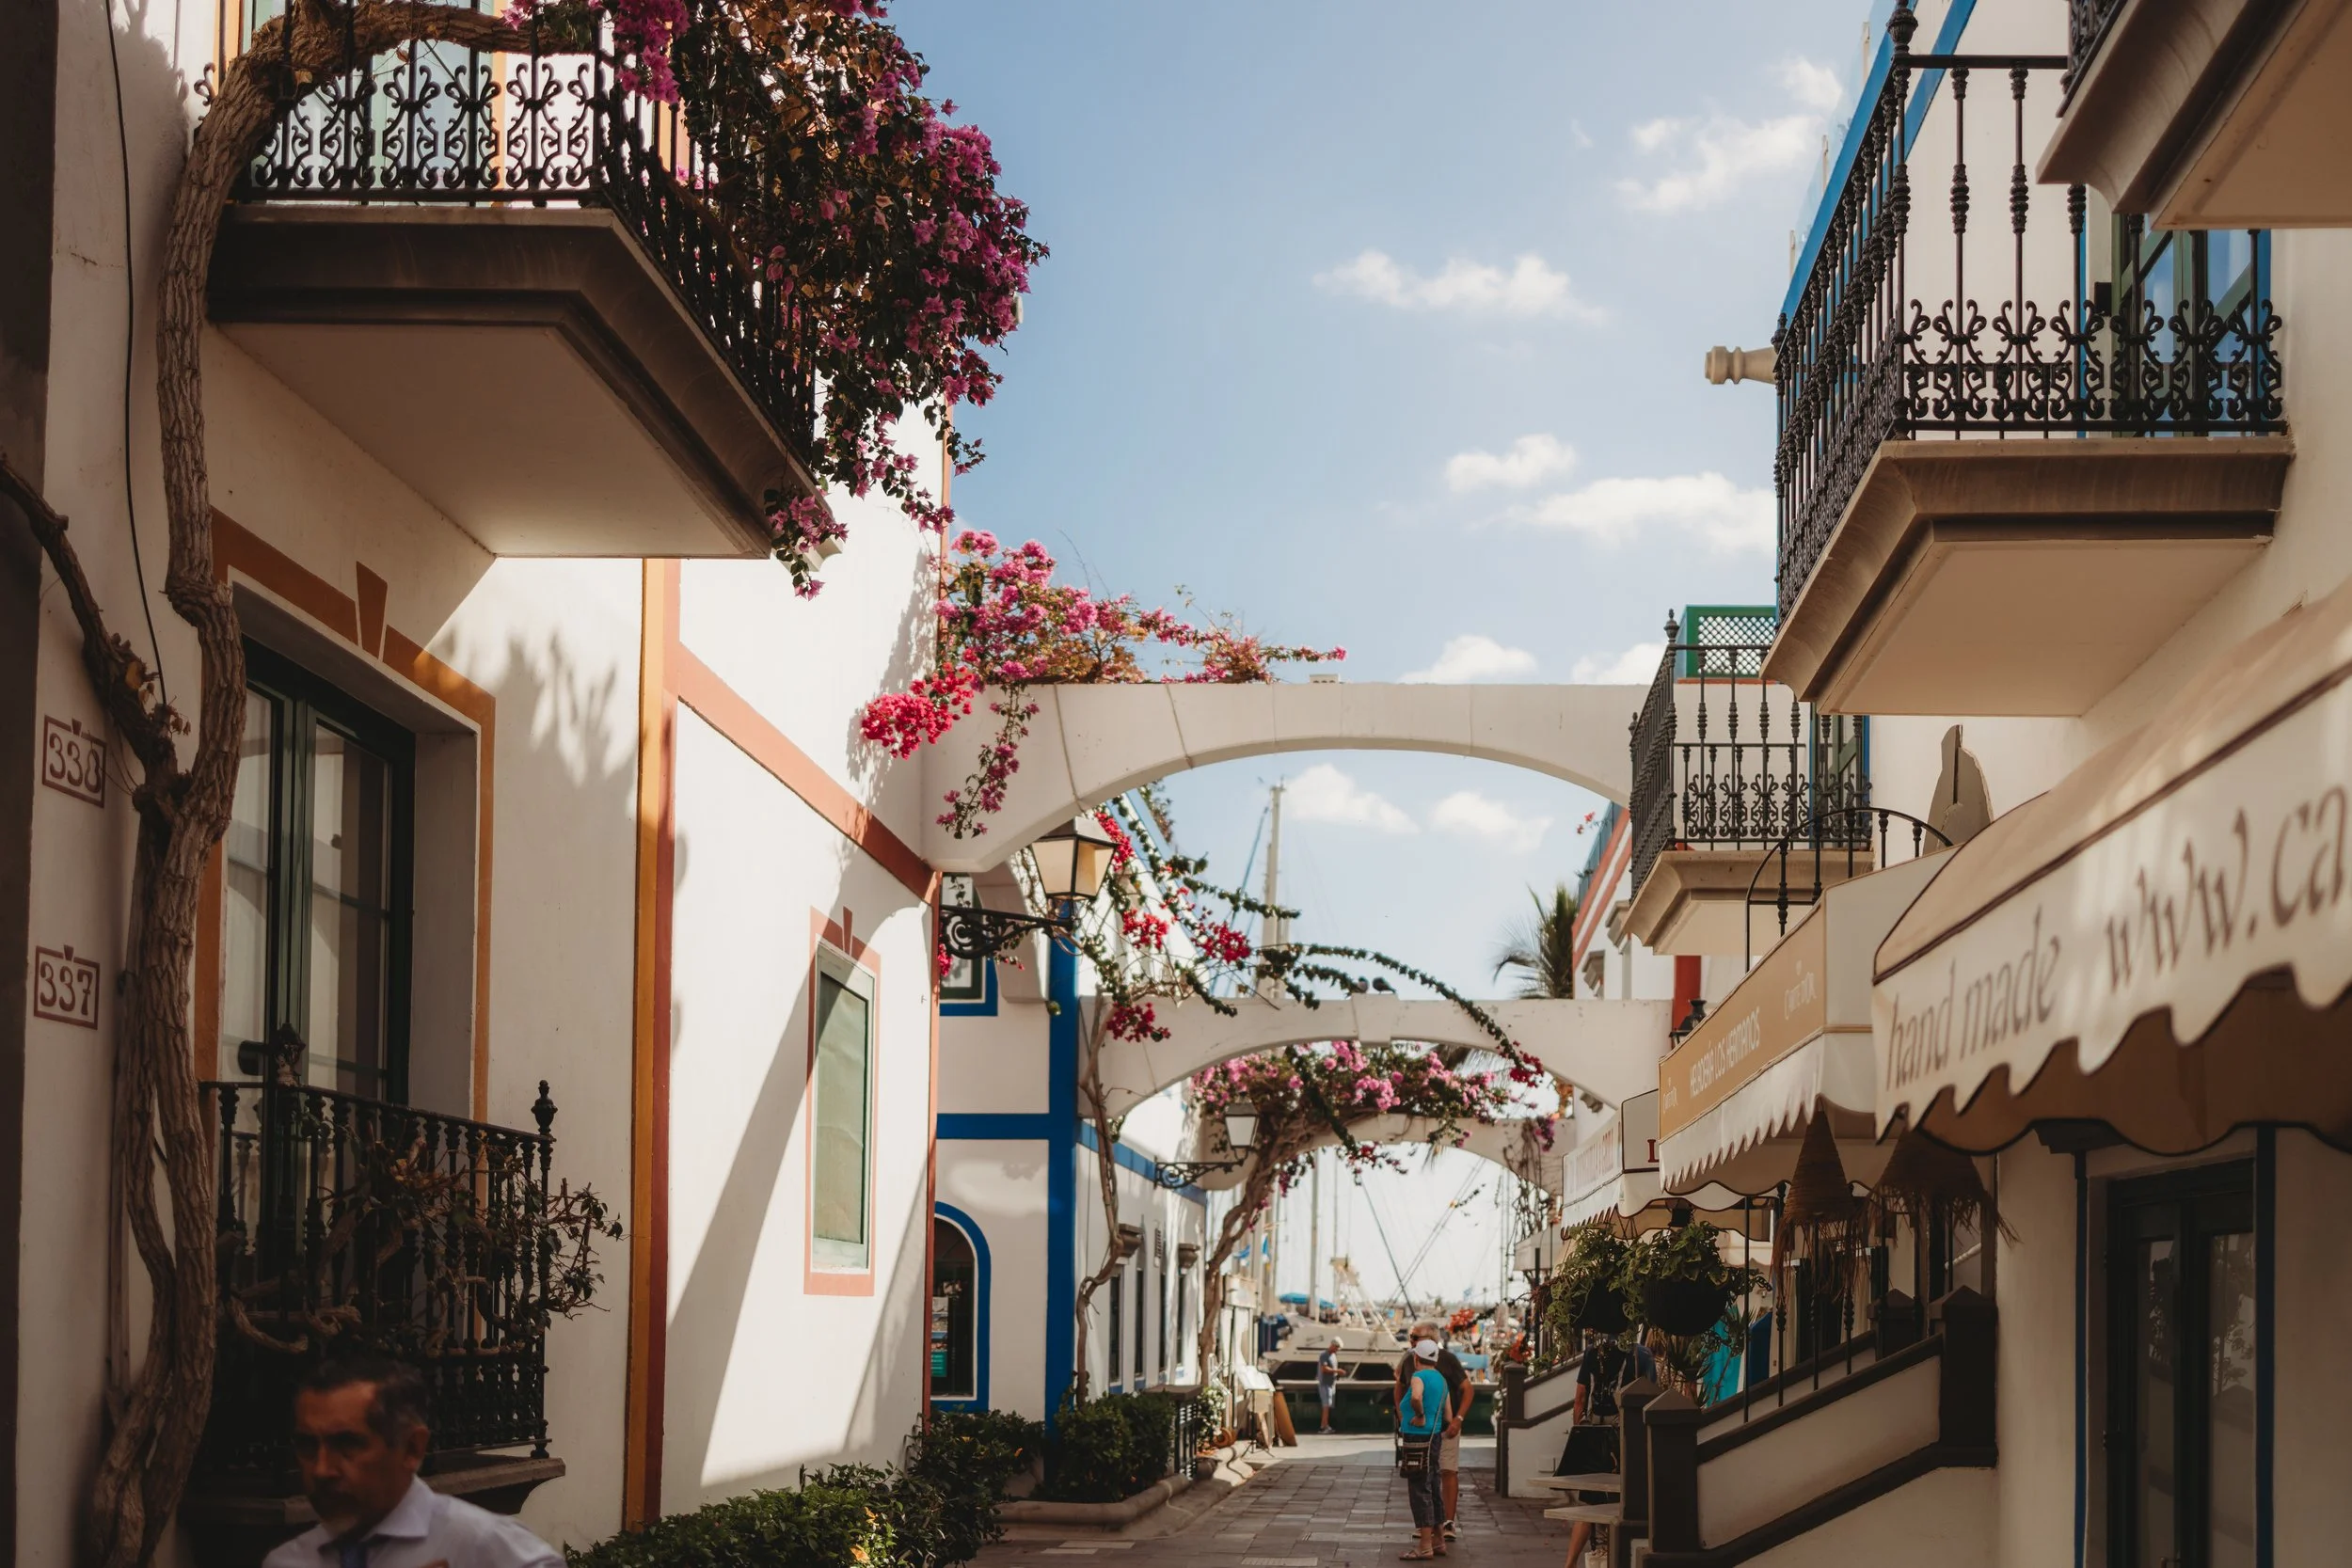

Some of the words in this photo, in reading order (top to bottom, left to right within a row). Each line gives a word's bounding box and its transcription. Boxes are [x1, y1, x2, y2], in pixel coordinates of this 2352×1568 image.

[49, 733, 102, 794] 338
[40, 961, 93, 1016] 337
[1885, 956, 1956, 1091] hand
[1960, 903, 2060, 1061] made
[1714, 1037, 1725, 1079] LOS
[1726, 1006, 1760, 1070] HERMANOS
